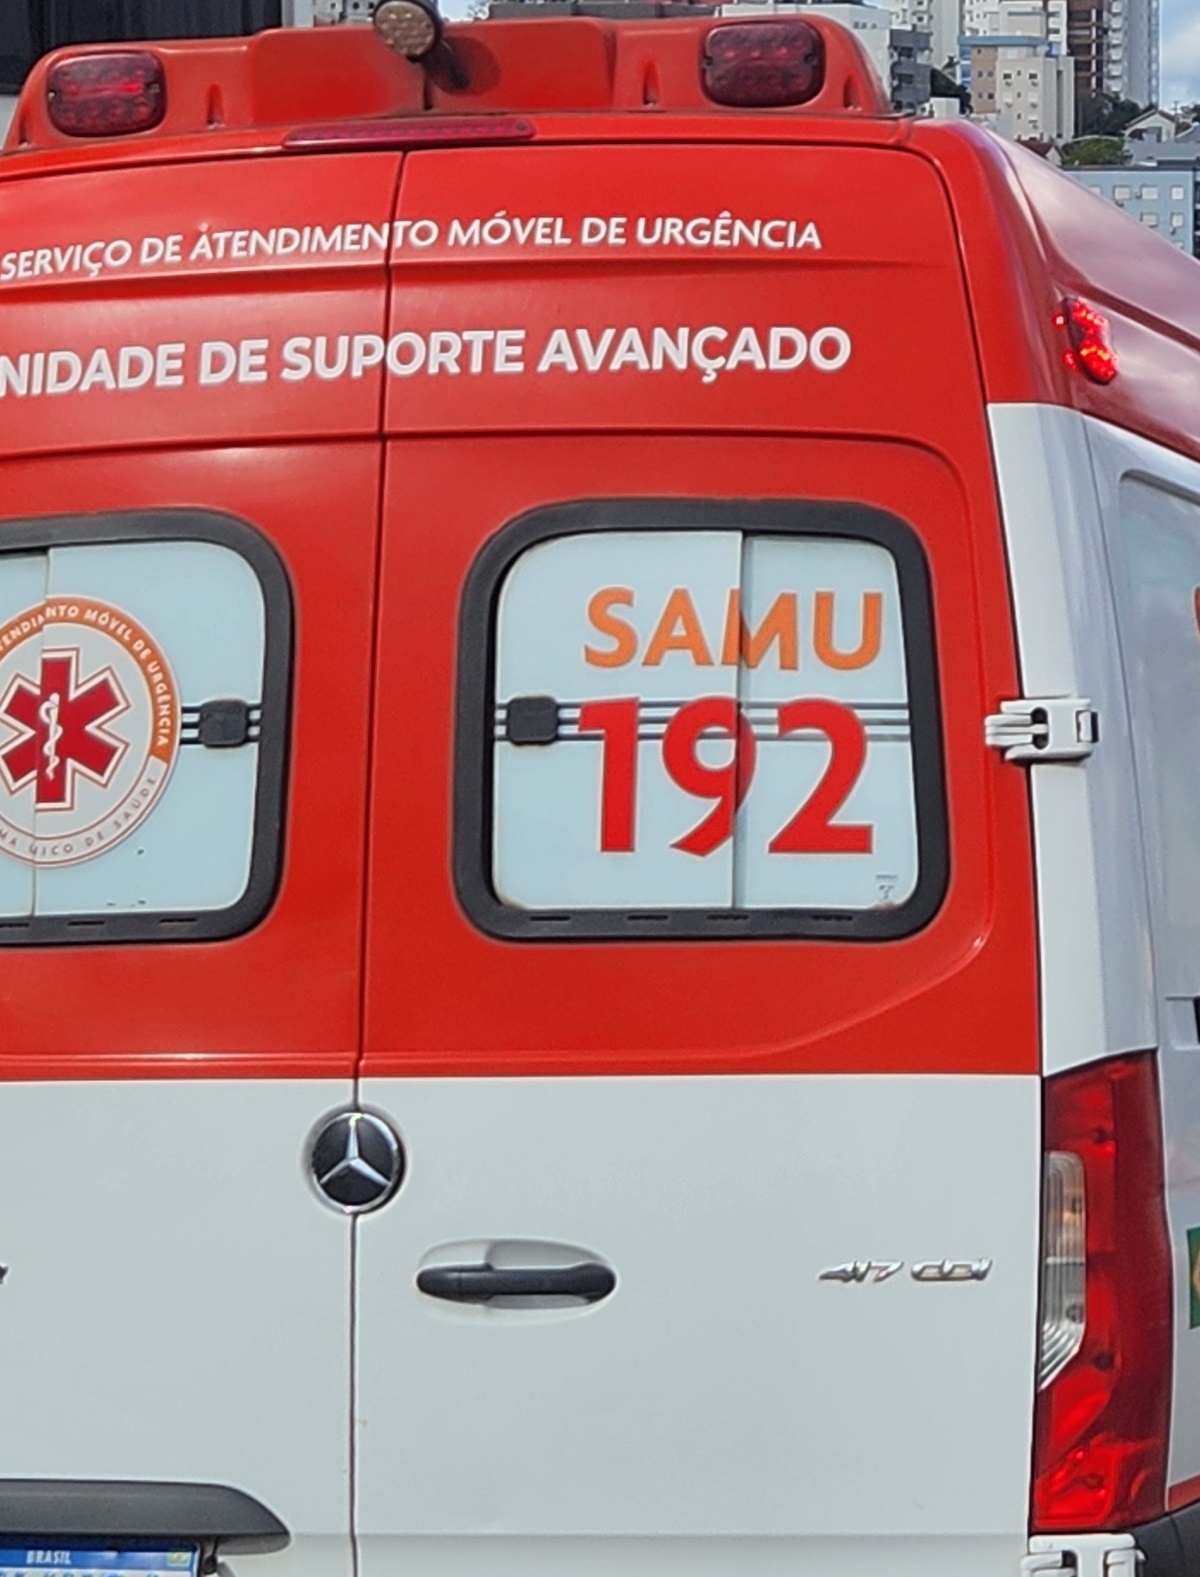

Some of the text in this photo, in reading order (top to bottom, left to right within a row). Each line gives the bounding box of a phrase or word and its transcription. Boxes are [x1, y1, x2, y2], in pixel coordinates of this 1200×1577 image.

[1, 211, 822, 280] SERVIÇO DE ATENDIMENTO MÓVEL DE URGÊNCIA
[199, 339, 268, 384] DE
[281, 330, 526, 380] SUPORTE
[538, 326, 851, 383] AVANÇADO
[132, 639, 152, 660] DE
[583, 586, 883, 670] SAMU
[578, 696, 874, 857] 192
[26, 1551, 72, 1565] BRASIL
